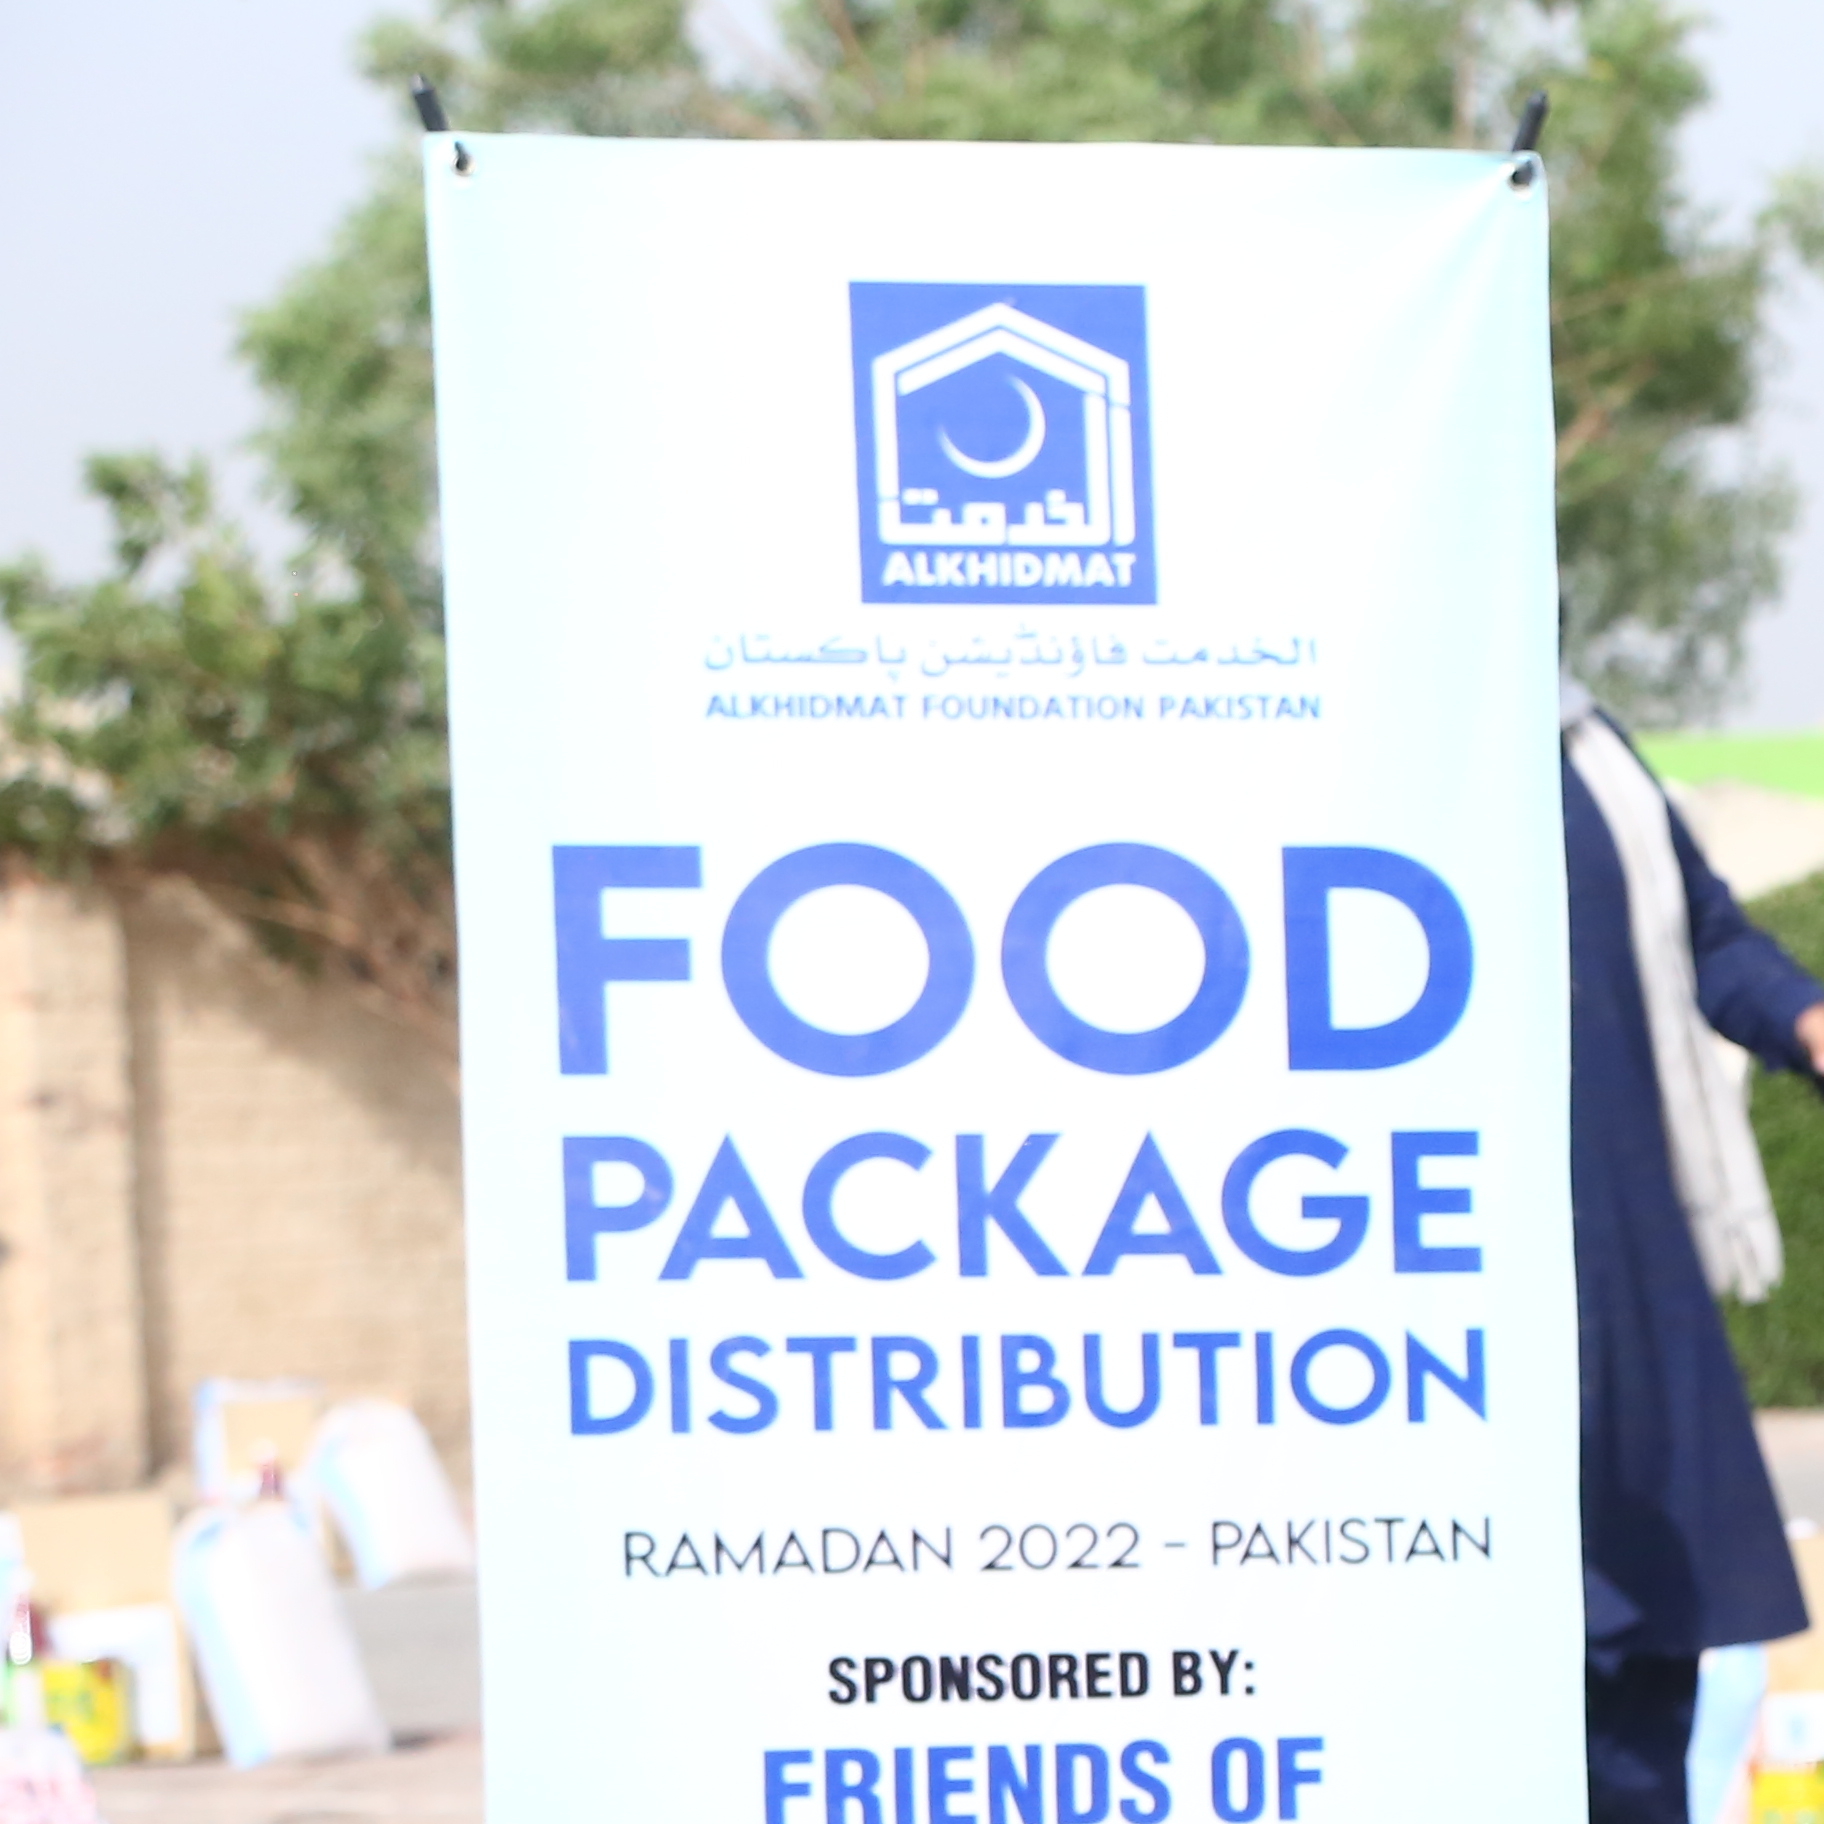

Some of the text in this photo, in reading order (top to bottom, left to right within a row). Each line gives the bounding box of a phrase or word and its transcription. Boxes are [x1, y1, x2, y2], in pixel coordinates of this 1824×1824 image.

[881, 551, 1137, 588] ALKHIDMAT
[705, 694, 1321, 720] ALKHIDMAT FOUNDATION PAKISTAN
[552, 842, 1473, 1077] FOOD
[562, 1127, 1483, 1281] PACKAGE
[567, 1327, 1487, 1435] DISTRIBUTION
[624, 1527, 952, 1577] RAMADAN
[979, 1522, 1141, 1572] 2022
[1211, 1517, 1492, 1566] PAKISTAN
[828, 1648, 1255, 1705] SPONSORED BY:
[1210, 1736, 1324, 1824] OF
